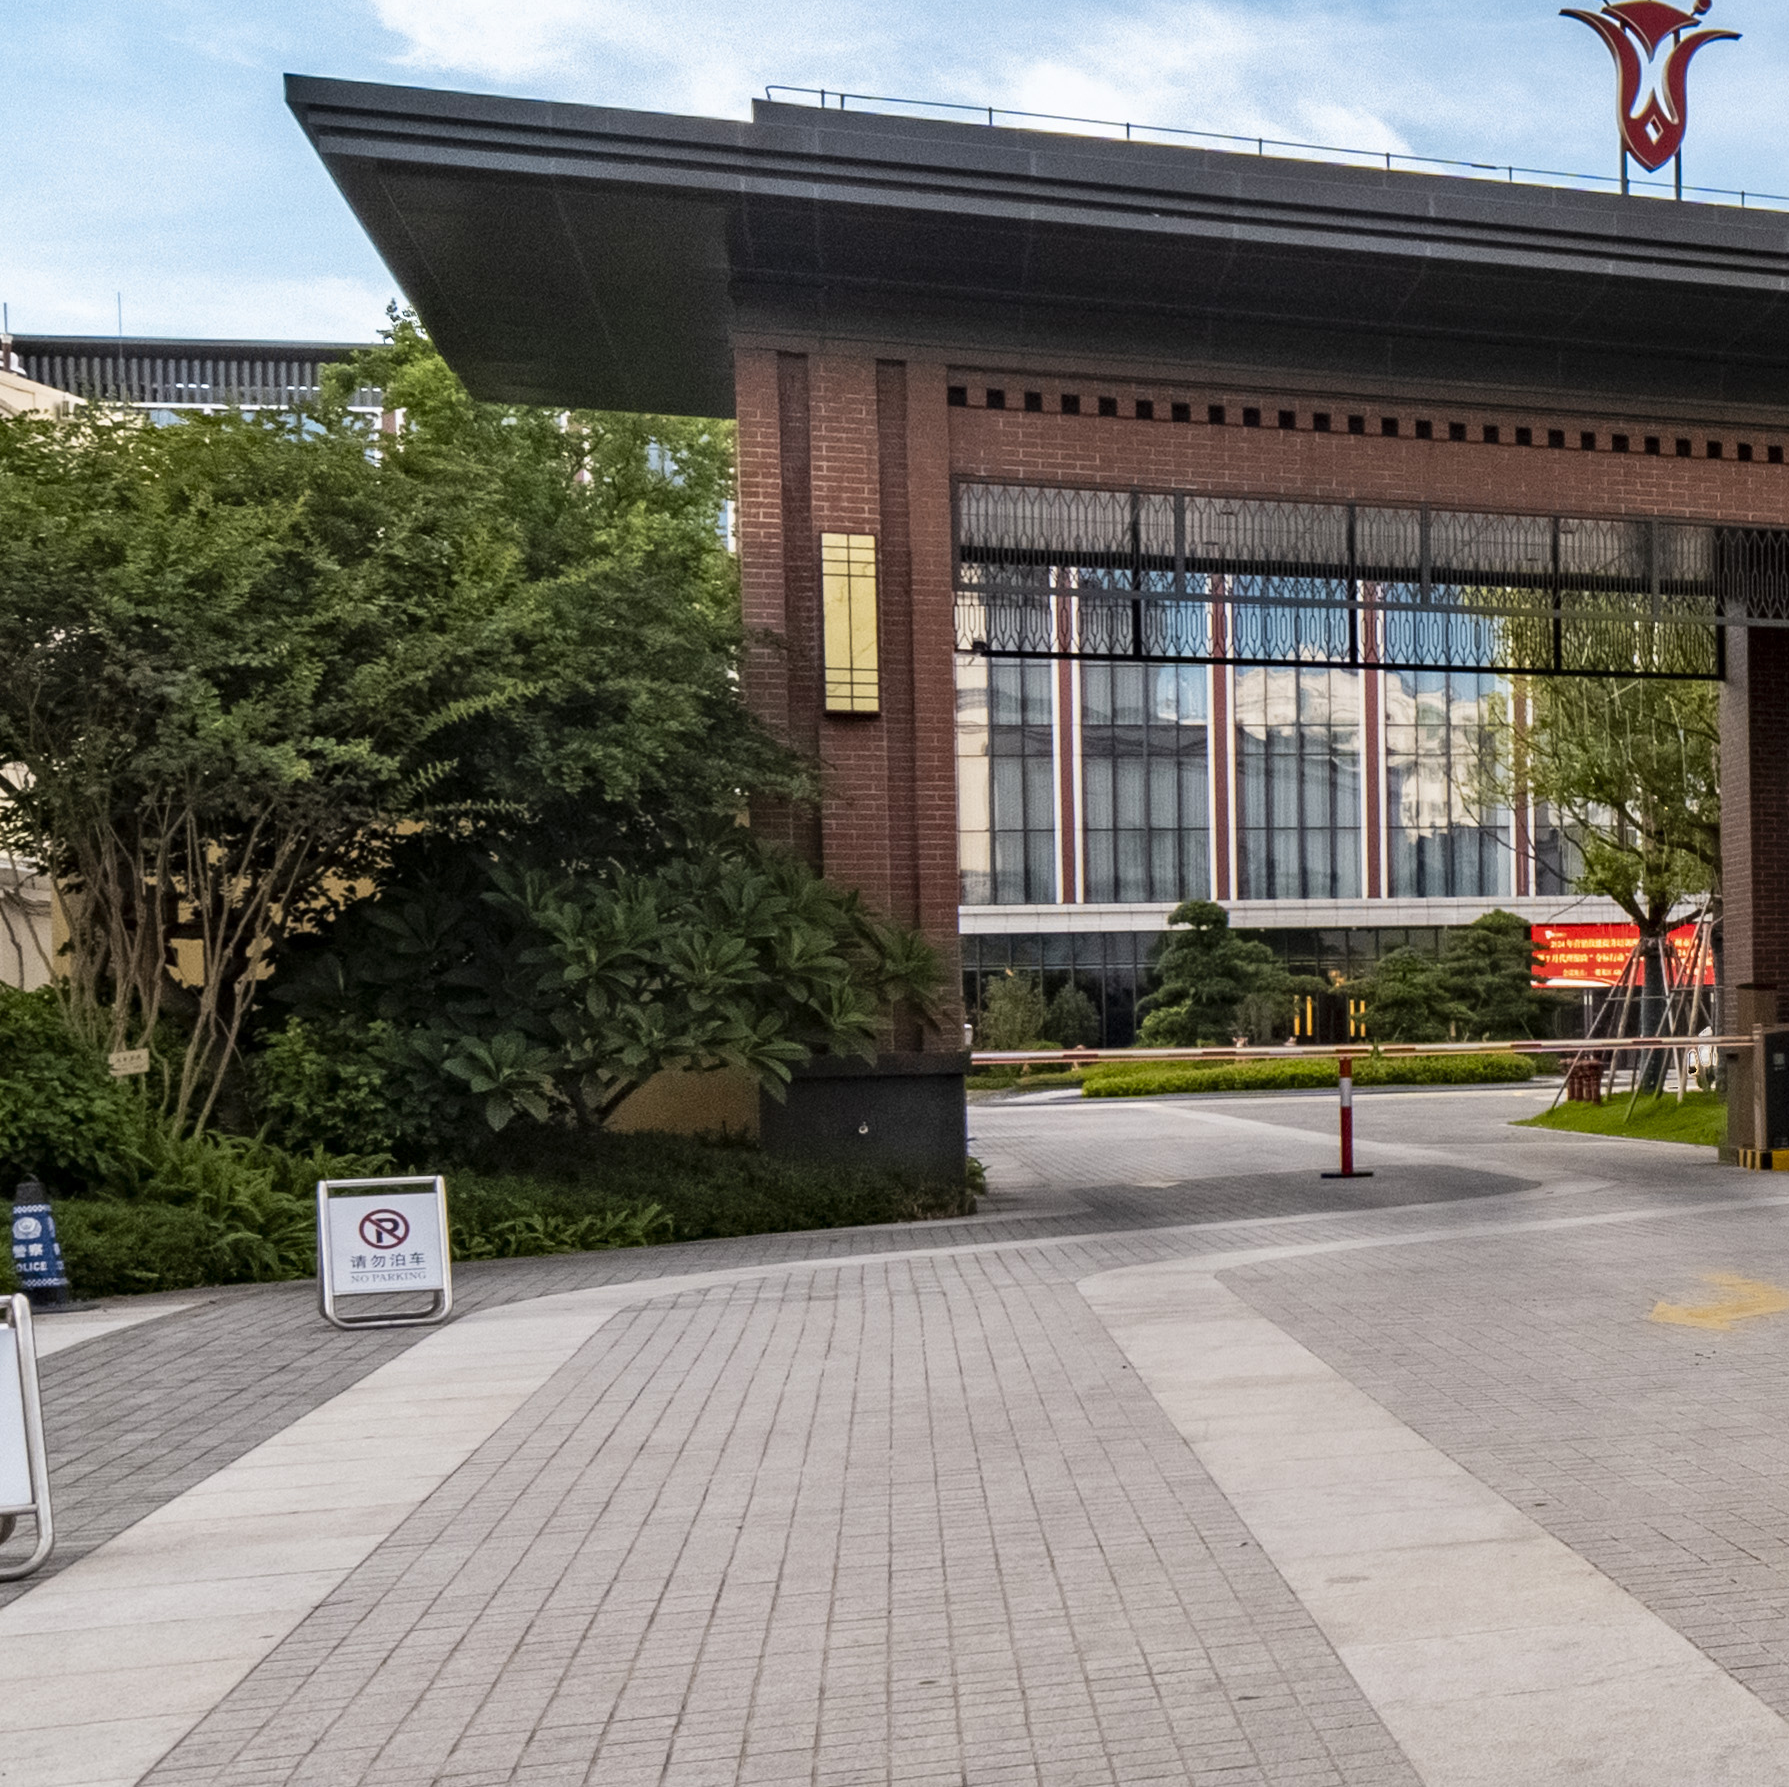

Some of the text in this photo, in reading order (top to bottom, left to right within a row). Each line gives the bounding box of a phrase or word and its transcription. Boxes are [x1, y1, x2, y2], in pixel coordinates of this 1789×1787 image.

[15, 1260, 48, 1273] OLICE
[350, 1252, 426, 1269] 请勿泊车
[351, 1271, 427, 1283] NO PARKING
